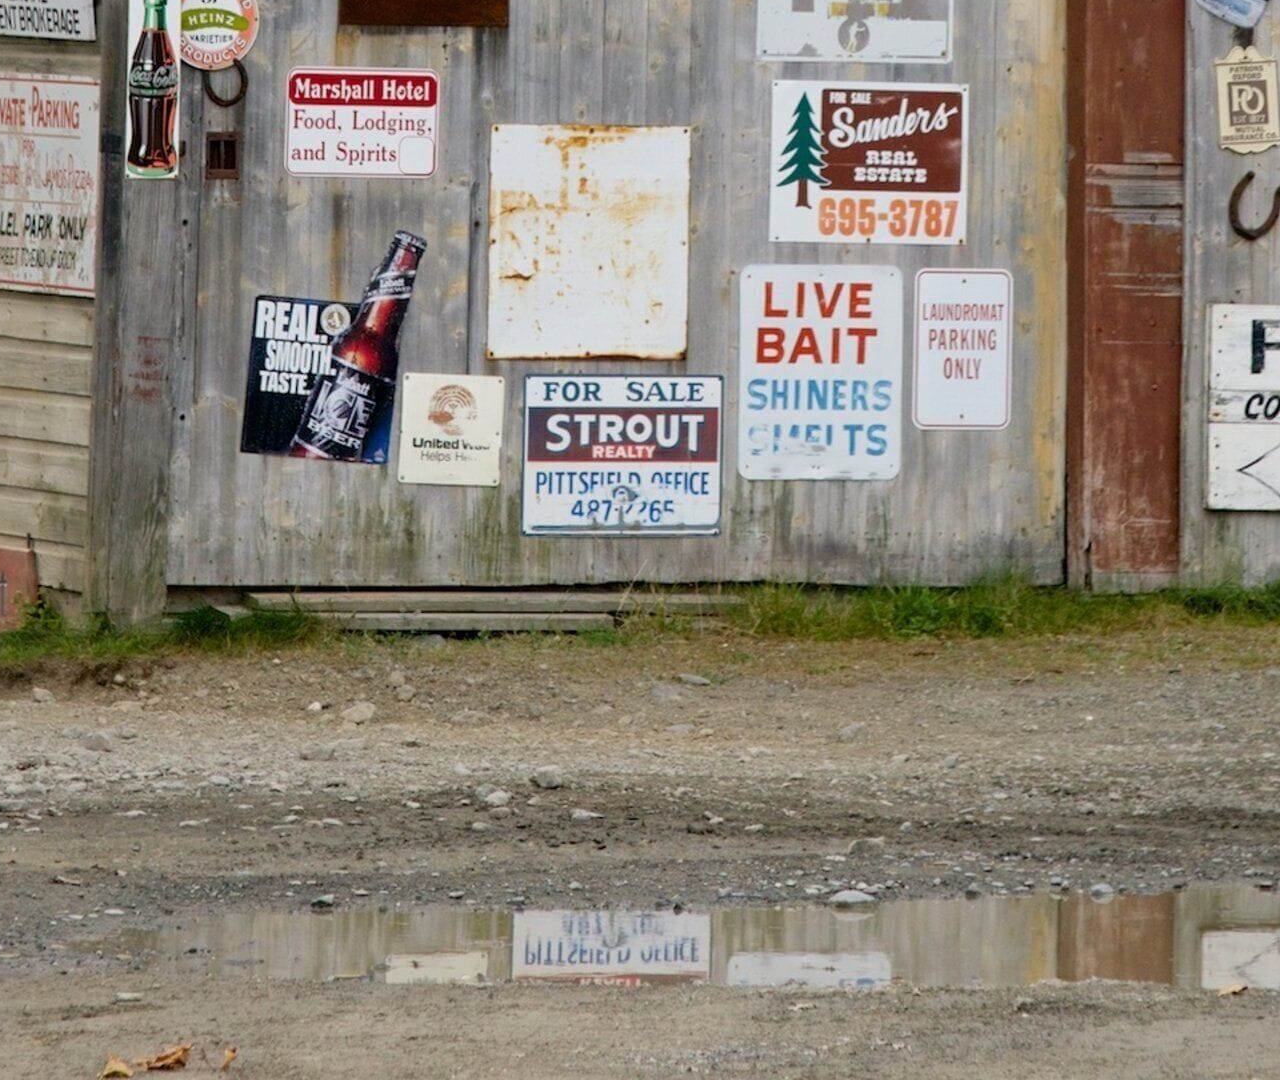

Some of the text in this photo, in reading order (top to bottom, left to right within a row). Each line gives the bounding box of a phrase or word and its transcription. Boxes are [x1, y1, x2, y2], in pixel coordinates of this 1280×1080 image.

[19, 5, 82, 35] BROKERAGE
[187, 12, 236, 27] HEINZ
[294, 77, 431, 103] Marshall Hotel
[829, 91, 872, 105] FOR SALE
[30, 86, 81, 130] PARKING
[352, 110, 433, 136] Lodging,
[828, 100, 960, 149] Sanders
[291, 141, 398, 166] and Spirits
[865, 149, 918, 167] REAL
[853, 166, 928, 184] ESTATE
[22, 212, 53, 240] PARK
[58, 214, 88, 242] ONLY
[817, 197, 960, 238] 695-3787
[762, 280, 875, 320] LIVE
[922, 302, 1006, 322] LAUNDROMAT
[255, 300, 329, 343] REAL.
[755, 326, 878, 365] BAIT
[927, 328, 999, 351] PARKING
[265, 340, 338, 378] SMOOTH.
[942, 357, 984, 380] ONLY
[259, 369, 310, 396] TASTE.
[542, 380, 706, 403] FOR SALE
[746, 378, 893, 412] SHINERS
[307, 416, 362, 449] BEER
[412, 436, 460, 450] United
[544, 413, 706, 453] STROUT
[591, 444, 657, 460] REALTY
[534, 470, 710, 496] PITTSFIELD OFFICE
[570, 498, 677, 523] 487-65
